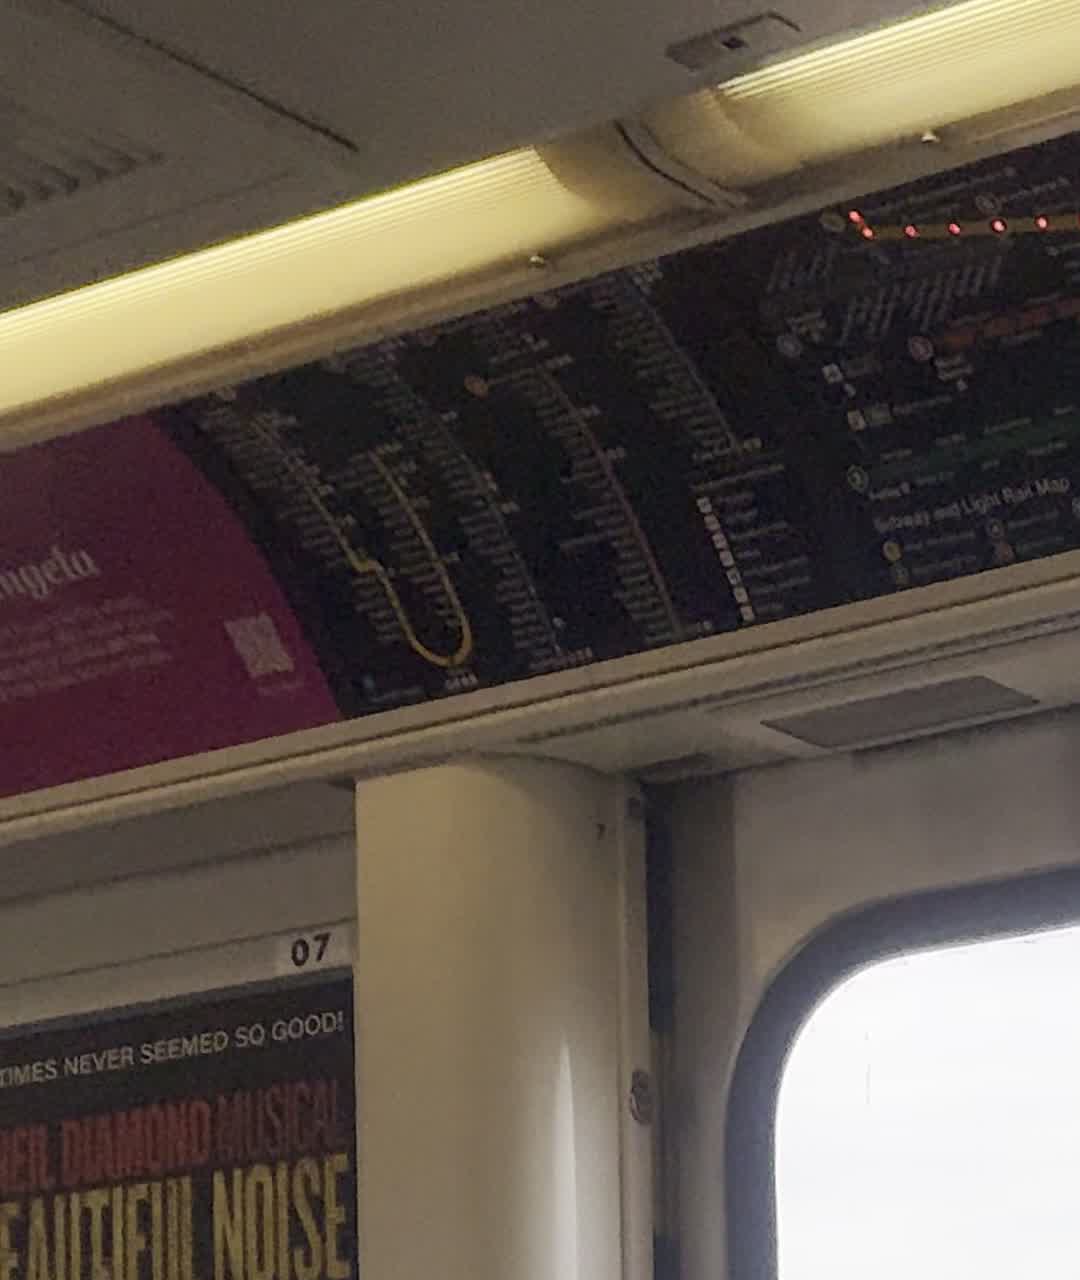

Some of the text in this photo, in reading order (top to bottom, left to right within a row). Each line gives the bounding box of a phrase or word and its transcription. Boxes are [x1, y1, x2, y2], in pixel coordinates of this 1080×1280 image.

[961, 493, 1002, 514] Light
[1002, 485, 1034, 505] Rail
[1036, 478, 1071, 496] Map
[291, 932, 330, 967] 07
[64, 1047, 134, 1076] NEVER
[140, 1031, 228, 1064] SEEMED
[235, 1024, 265, 1048] SO
[271, 1011, 344, 1041] GOOD!
[62, 1101, 210, 1187] DIAMOND
[213, 1080, 342, 1162] MUSICAL
